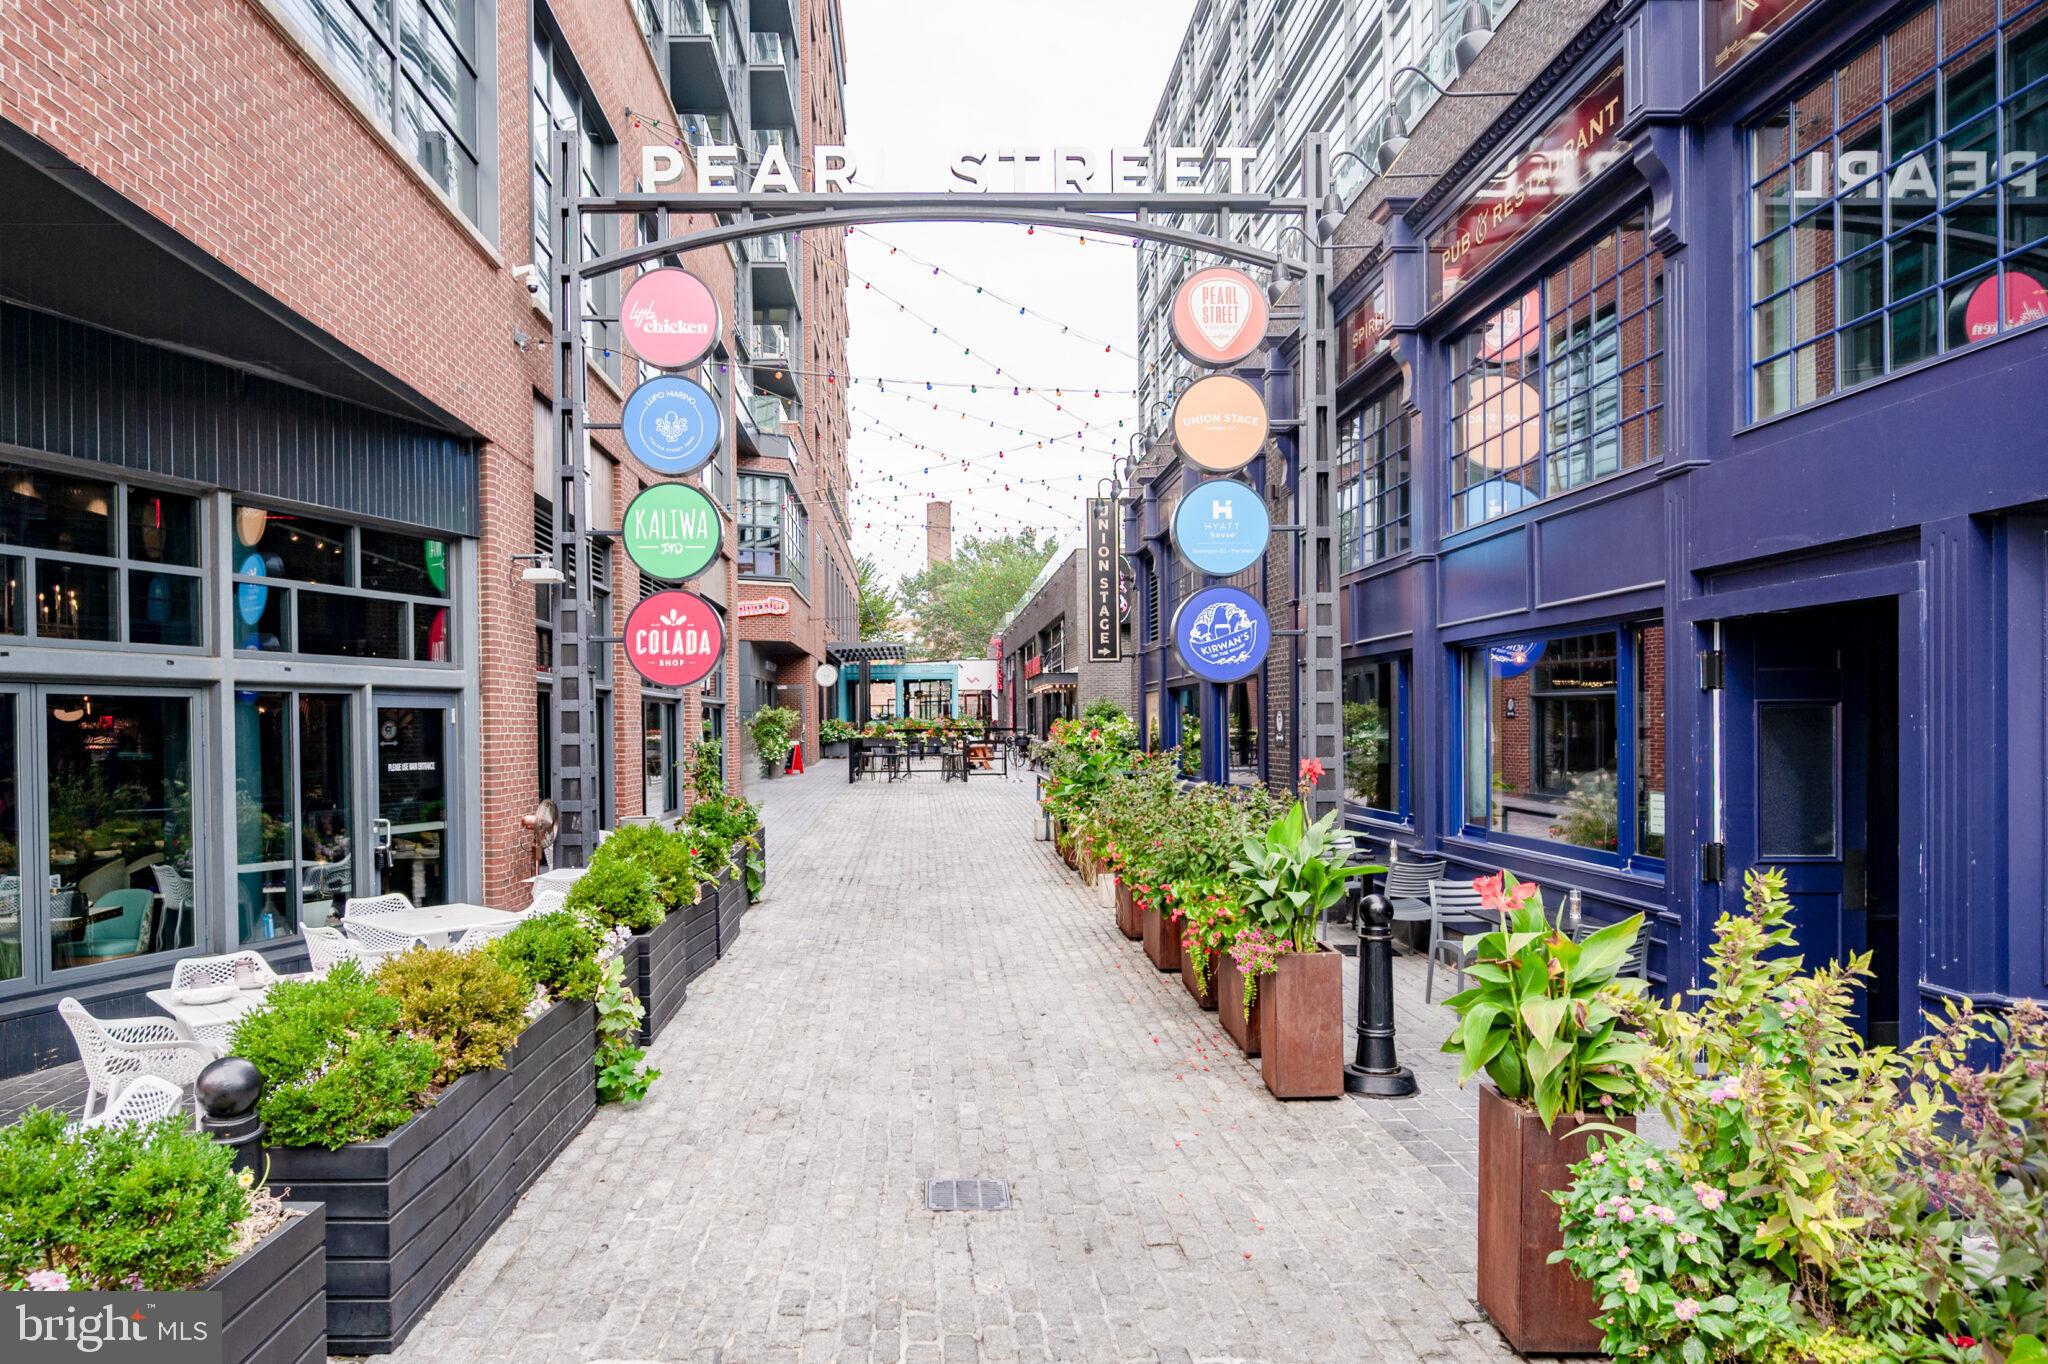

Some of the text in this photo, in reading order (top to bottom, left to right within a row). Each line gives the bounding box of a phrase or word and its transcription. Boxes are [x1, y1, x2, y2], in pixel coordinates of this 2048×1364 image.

[642, 145, 1257, 194] PEAR STREET
[1443, 95, 1619, 273] PUB & RESTAURANT
[1202, 286, 1239, 305] PEARL
[1202, 305, 1239, 324] STREET
[643, 318, 708, 334] chicken
[644, 390, 697, 407] LUPO MARINO
[1182, 413, 1260, 427] UNION STAGE
[635, 507, 708, 540] KALIWA
[1204, 522, 1240, 531] HYATT
[1210, 531, 1236, 539] house
[1098, 577, 1110, 645] STAGE
[635, 629, 711, 655] COLADA
[1200, 631, 1250, 655] KIRWAN'S
[1219, 648, 1230, 657] THE
[1230, 642, 1246, 654] WHARF
[659, 659, 685, 667] SHOP
